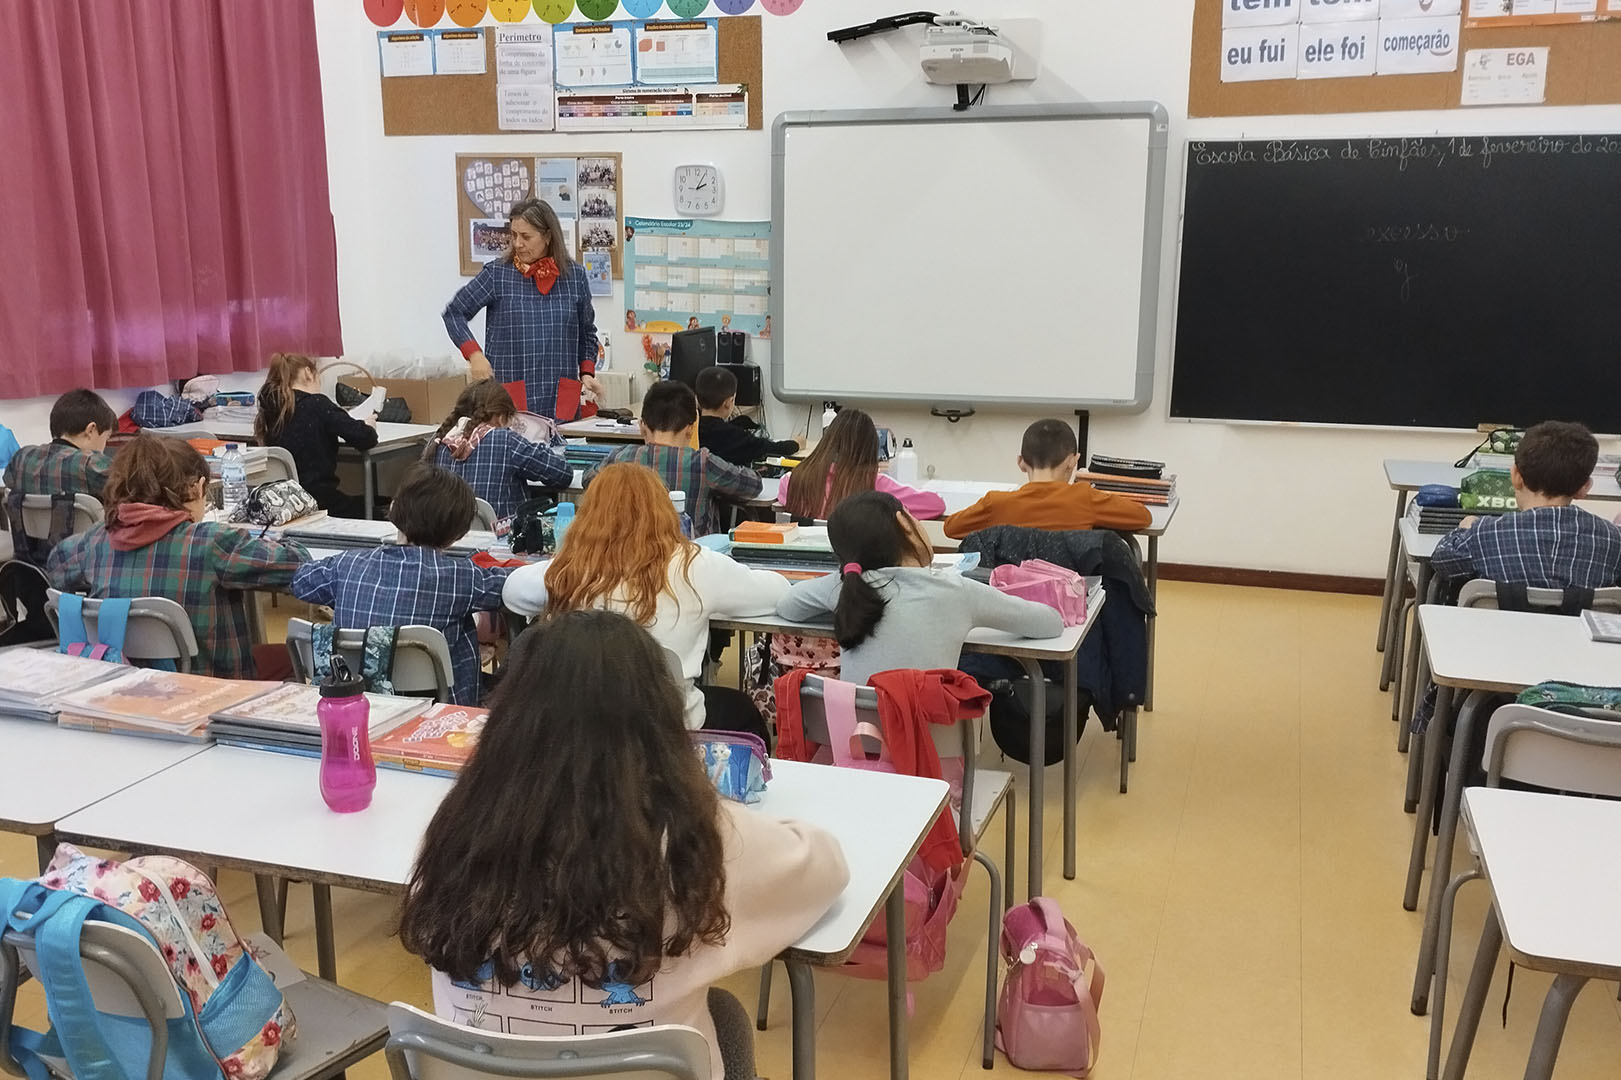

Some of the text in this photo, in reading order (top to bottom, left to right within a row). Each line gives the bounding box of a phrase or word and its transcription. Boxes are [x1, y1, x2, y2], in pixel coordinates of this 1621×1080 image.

[1305, 35, 1365, 62] ele foi
[1383, 29, 1450, 55] começarão
[1227, 38, 1285, 65] eu fui
[1507, 52, 1535, 66] EGA
[1192, 141, 1256, 164] Escola
[1263, 140, 1331, 163] Básica
[1341, 140, 1360, 160] de
[1448, 137, 1455, 154] 1
[1460, 137, 1474, 157] de
[1480, 135, 1566, 168] fevereiro
[1572, 135, 1592, 154] de
[1596, 136, 1621, 154] 20
[694, 168, 701, 177] 12
[695, 202, 700, 210] 6
[704, 201, 709, 210] 5
[1477, 495, 1518, 509] XBO
[530, 1004, 553, 1012] STITCH
[609, 1007, 633, 1015] STITCH
